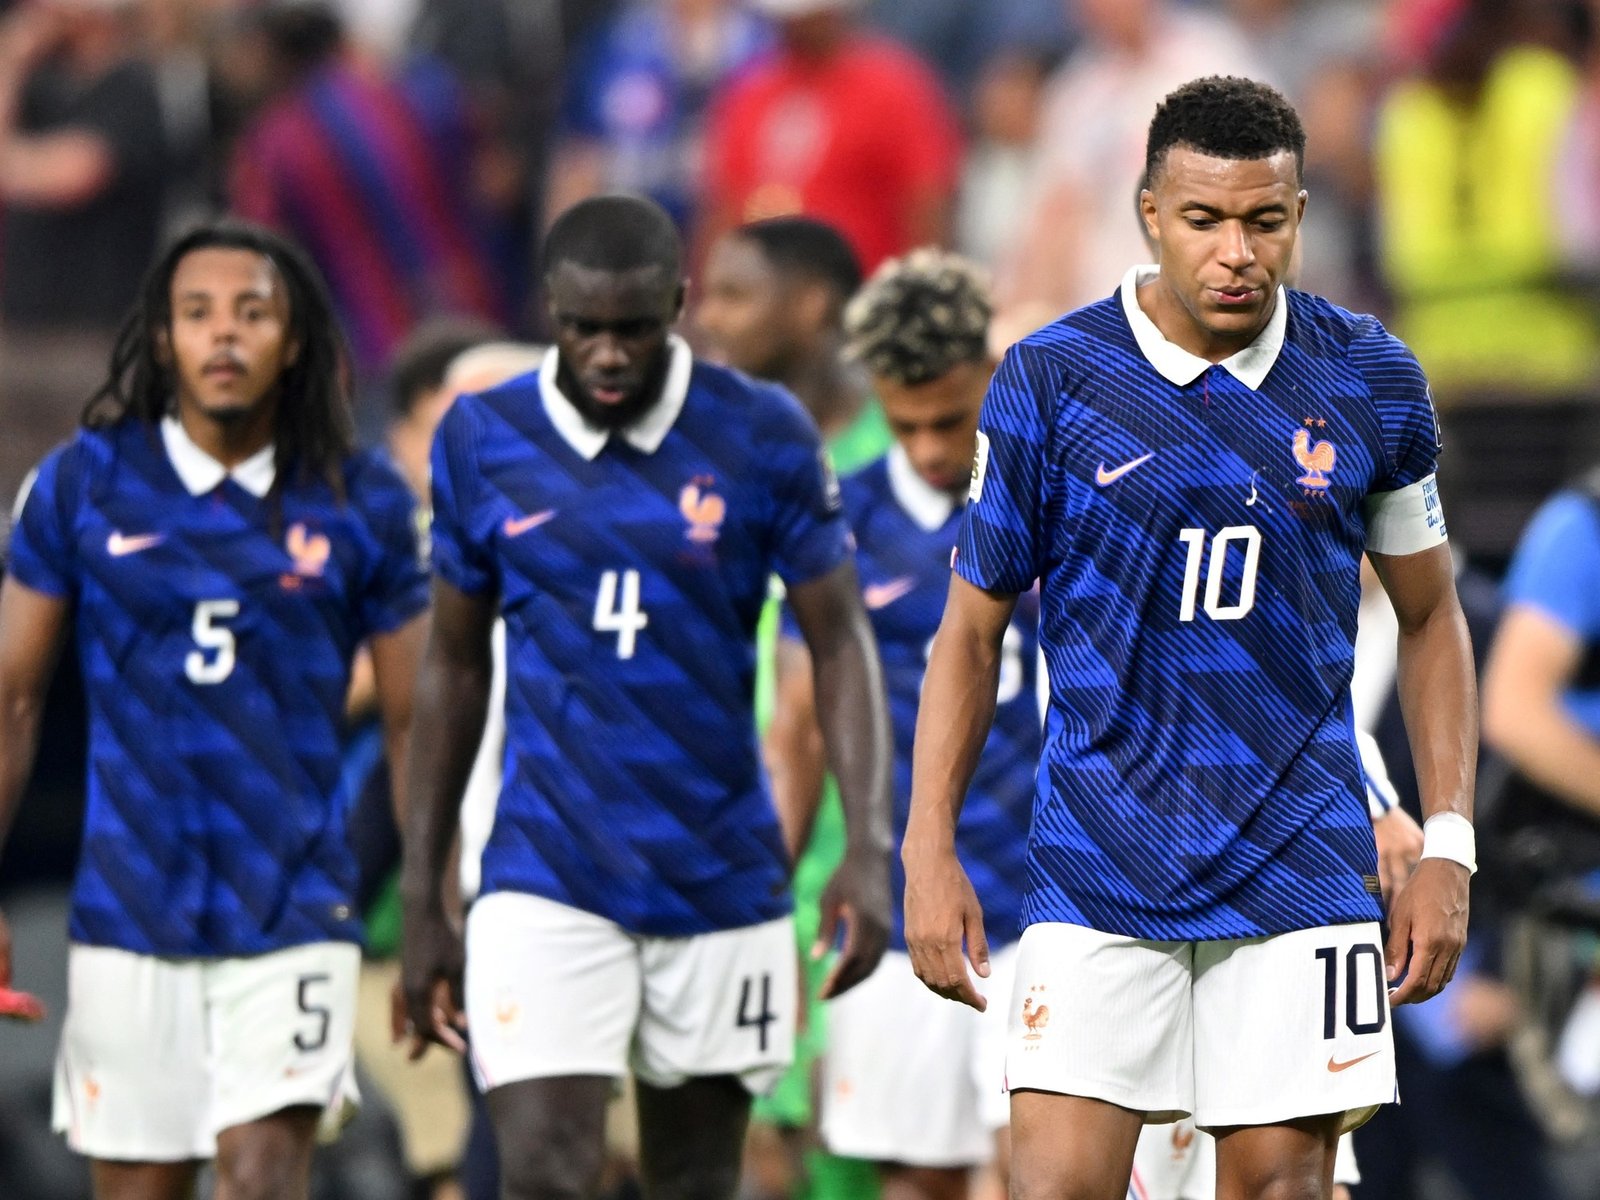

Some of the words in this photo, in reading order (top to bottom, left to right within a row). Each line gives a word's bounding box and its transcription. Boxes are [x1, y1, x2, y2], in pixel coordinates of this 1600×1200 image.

[592, 570, 649, 660] 4
[1178, 525, 1262, 622] 10
[184, 599, 240, 685] 5
[292, 972, 331, 1053] 5
[736, 974, 777, 1052] 4
[1314, 943, 1386, 1040] 10
